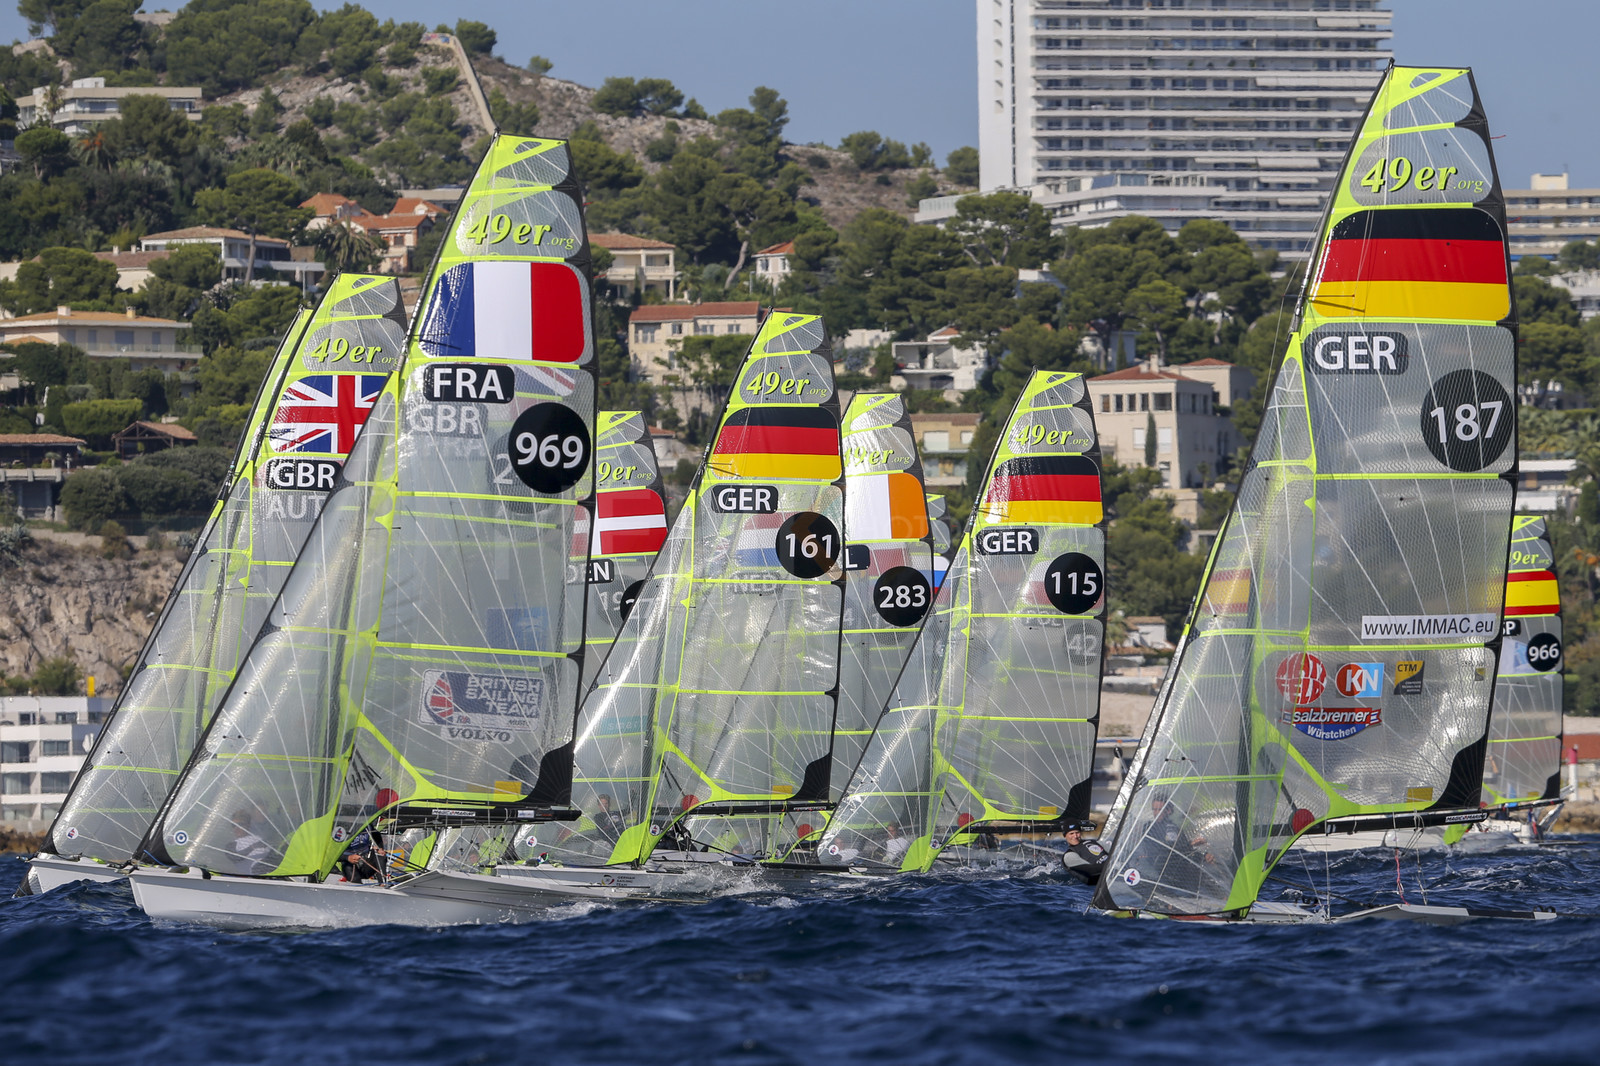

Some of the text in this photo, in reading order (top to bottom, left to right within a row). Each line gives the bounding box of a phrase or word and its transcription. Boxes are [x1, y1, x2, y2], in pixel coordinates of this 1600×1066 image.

[1314, 335, 1397, 371] GER
[433, 367, 505, 400] FRA
[410, 404, 480, 435] GBR
[1430, 400, 1503, 444] 187
[515, 431, 583, 469] 969
[273, 462, 336, 489] GBR
[718, 488, 771, 511] GER
[785, 533, 832, 559] 161
[982, 531, 1033, 554] GER
[1051, 571, 1098, 596] 115
[879, 584, 926, 609] 283
[1364, 617, 1494, 636] www.IMMAC.eu
[1528, 643, 1560, 662] 966
[1397, 664, 1418, 672] CTM
[467, 676, 540, 693] BRITISH
[1345, 669, 1379, 692] KN
[465, 687, 539, 704] SAILING
[485, 701, 537, 717] TEAM
[448, 727, 511, 743] VOLVO
